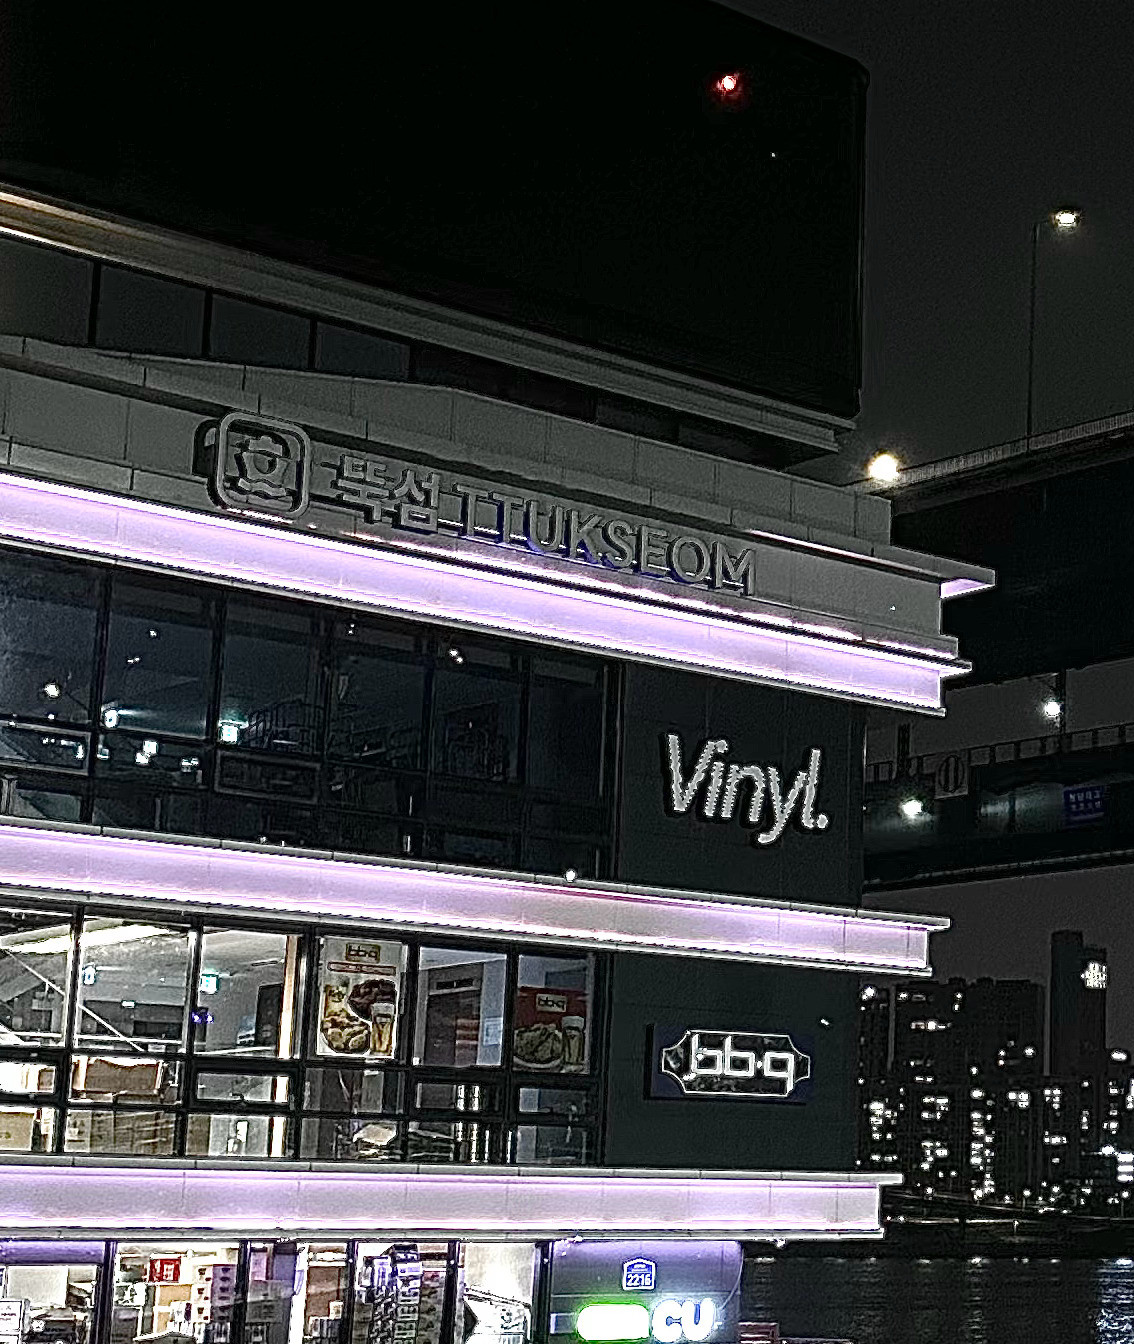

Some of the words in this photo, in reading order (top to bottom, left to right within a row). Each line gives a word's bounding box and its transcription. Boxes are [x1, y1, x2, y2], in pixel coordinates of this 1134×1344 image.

[337, 455, 439, 533] 뚝섬
[455, 485, 756, 596] TTUKSEOM
[651, 1297, 718, 1343] CU
